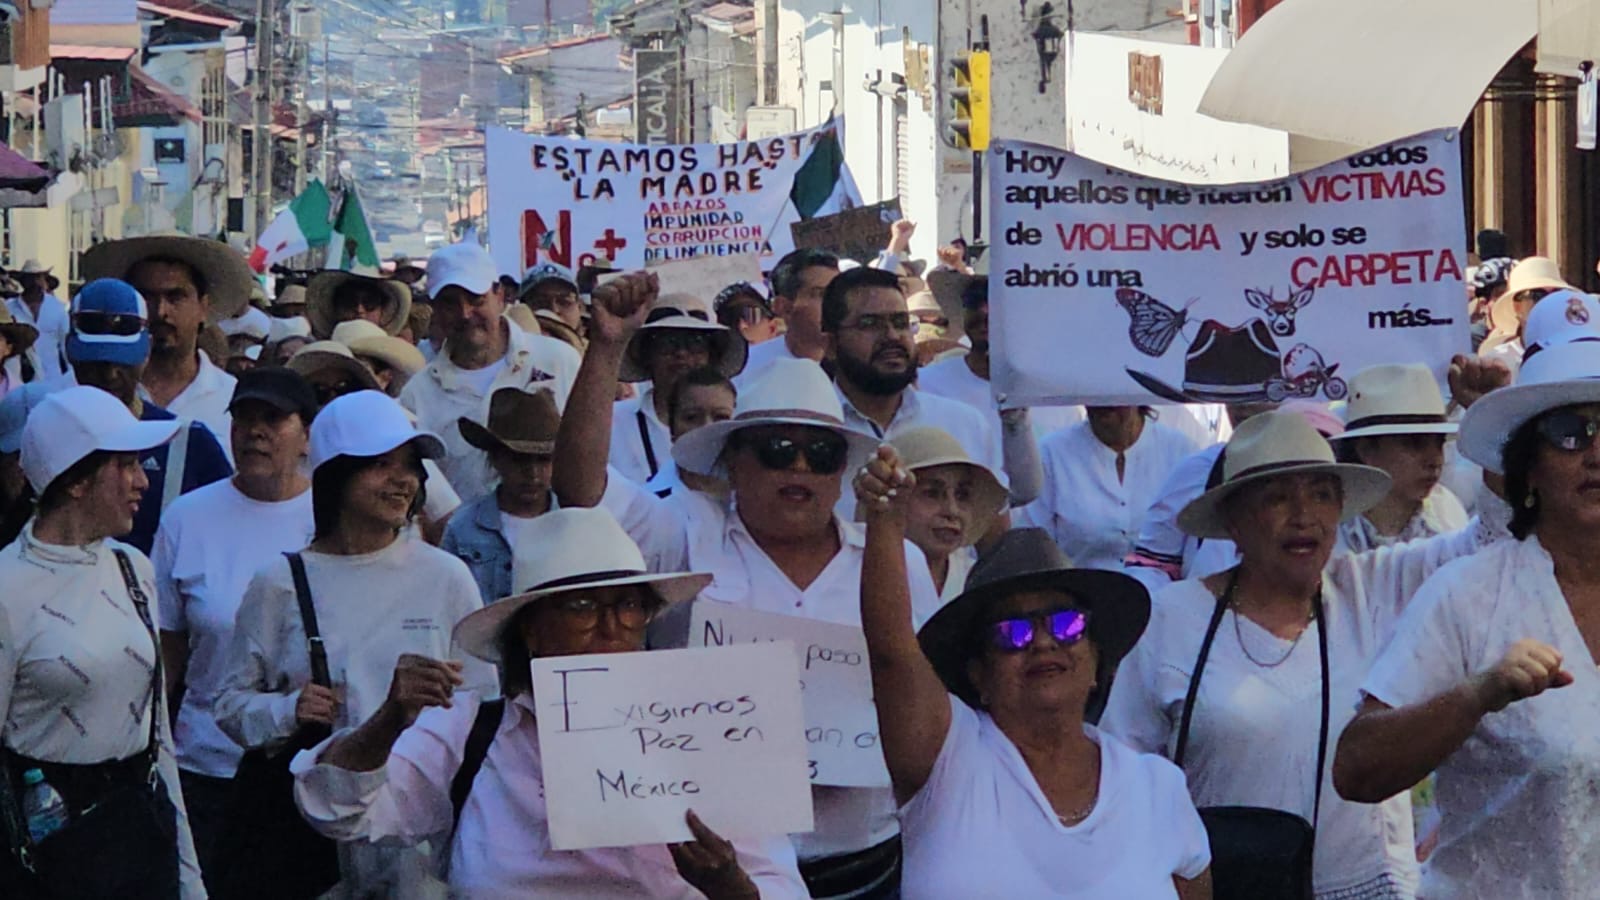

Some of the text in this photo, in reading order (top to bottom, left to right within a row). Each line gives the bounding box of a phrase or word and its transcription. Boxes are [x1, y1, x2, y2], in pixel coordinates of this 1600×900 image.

[531, 144, 698, 174] ESTAMOS
[1005, 145, 1428, 179] Hoy todos
[1005, 179, 1129, 209] aquellos
[1135, 183, 1192, 211] que
[1299, 167, 1446, 203] VICTIMAS
[643, 211, 744, 231] IMPUNIDAD
[647, 198, 727, 214] ABRAZOS
[646, 225, 762, 246] CORRUPCION
[1005, 223, 1367, 255] de VIOLENCIA y solo se
[1005, 248, 1462, 289] abrió una CARPETA
[634, 726, 764, 755] Paz en
[596, 768, 701, 802] México
